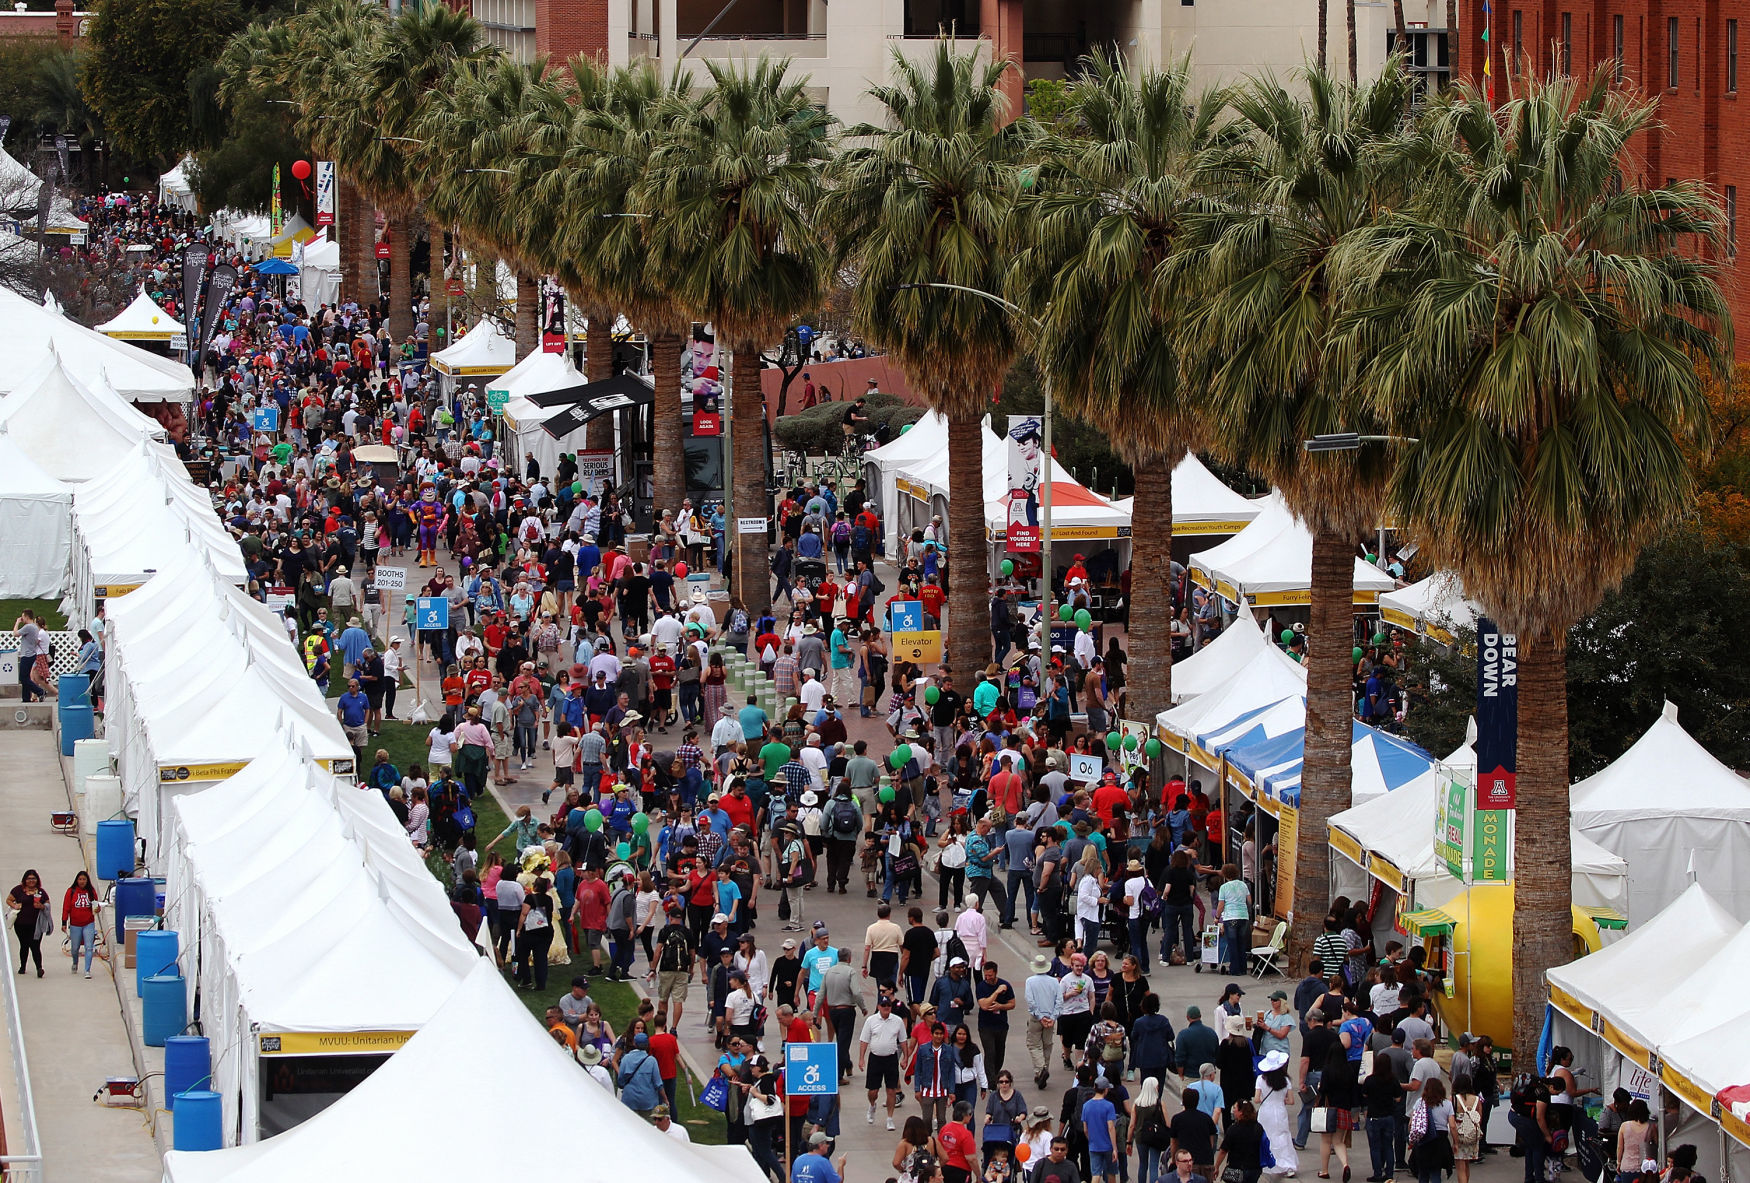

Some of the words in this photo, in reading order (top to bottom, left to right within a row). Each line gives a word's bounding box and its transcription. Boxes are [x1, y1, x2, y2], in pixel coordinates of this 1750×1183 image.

[197, 267, 205, 284] Center
[193, 284, 202, 305] Medical
[205, 327, 214, 345] Tucson
[211, 306, 222, 328] Medical
[219, 290, 229, 307] Center
[377, 569, 404, 579] BOOTHS
[377, 579, 403, 588] 201-250
[901, 638, 932, 646] Elevator
[1483, 633, 1498, 697] DOWN
[1502, 633, 1517, 688] BEAR
[1129, 752, 1139, 761] PBS
[1448, 824, 1463, 846] REAL
[1482, 810, 1498, 879] MONADE
[319, 1036, 350, 1046] MVUU:
[352, 1035, 394, 1045] Unitarian
[1630, 1068, 1652, 1094] life
